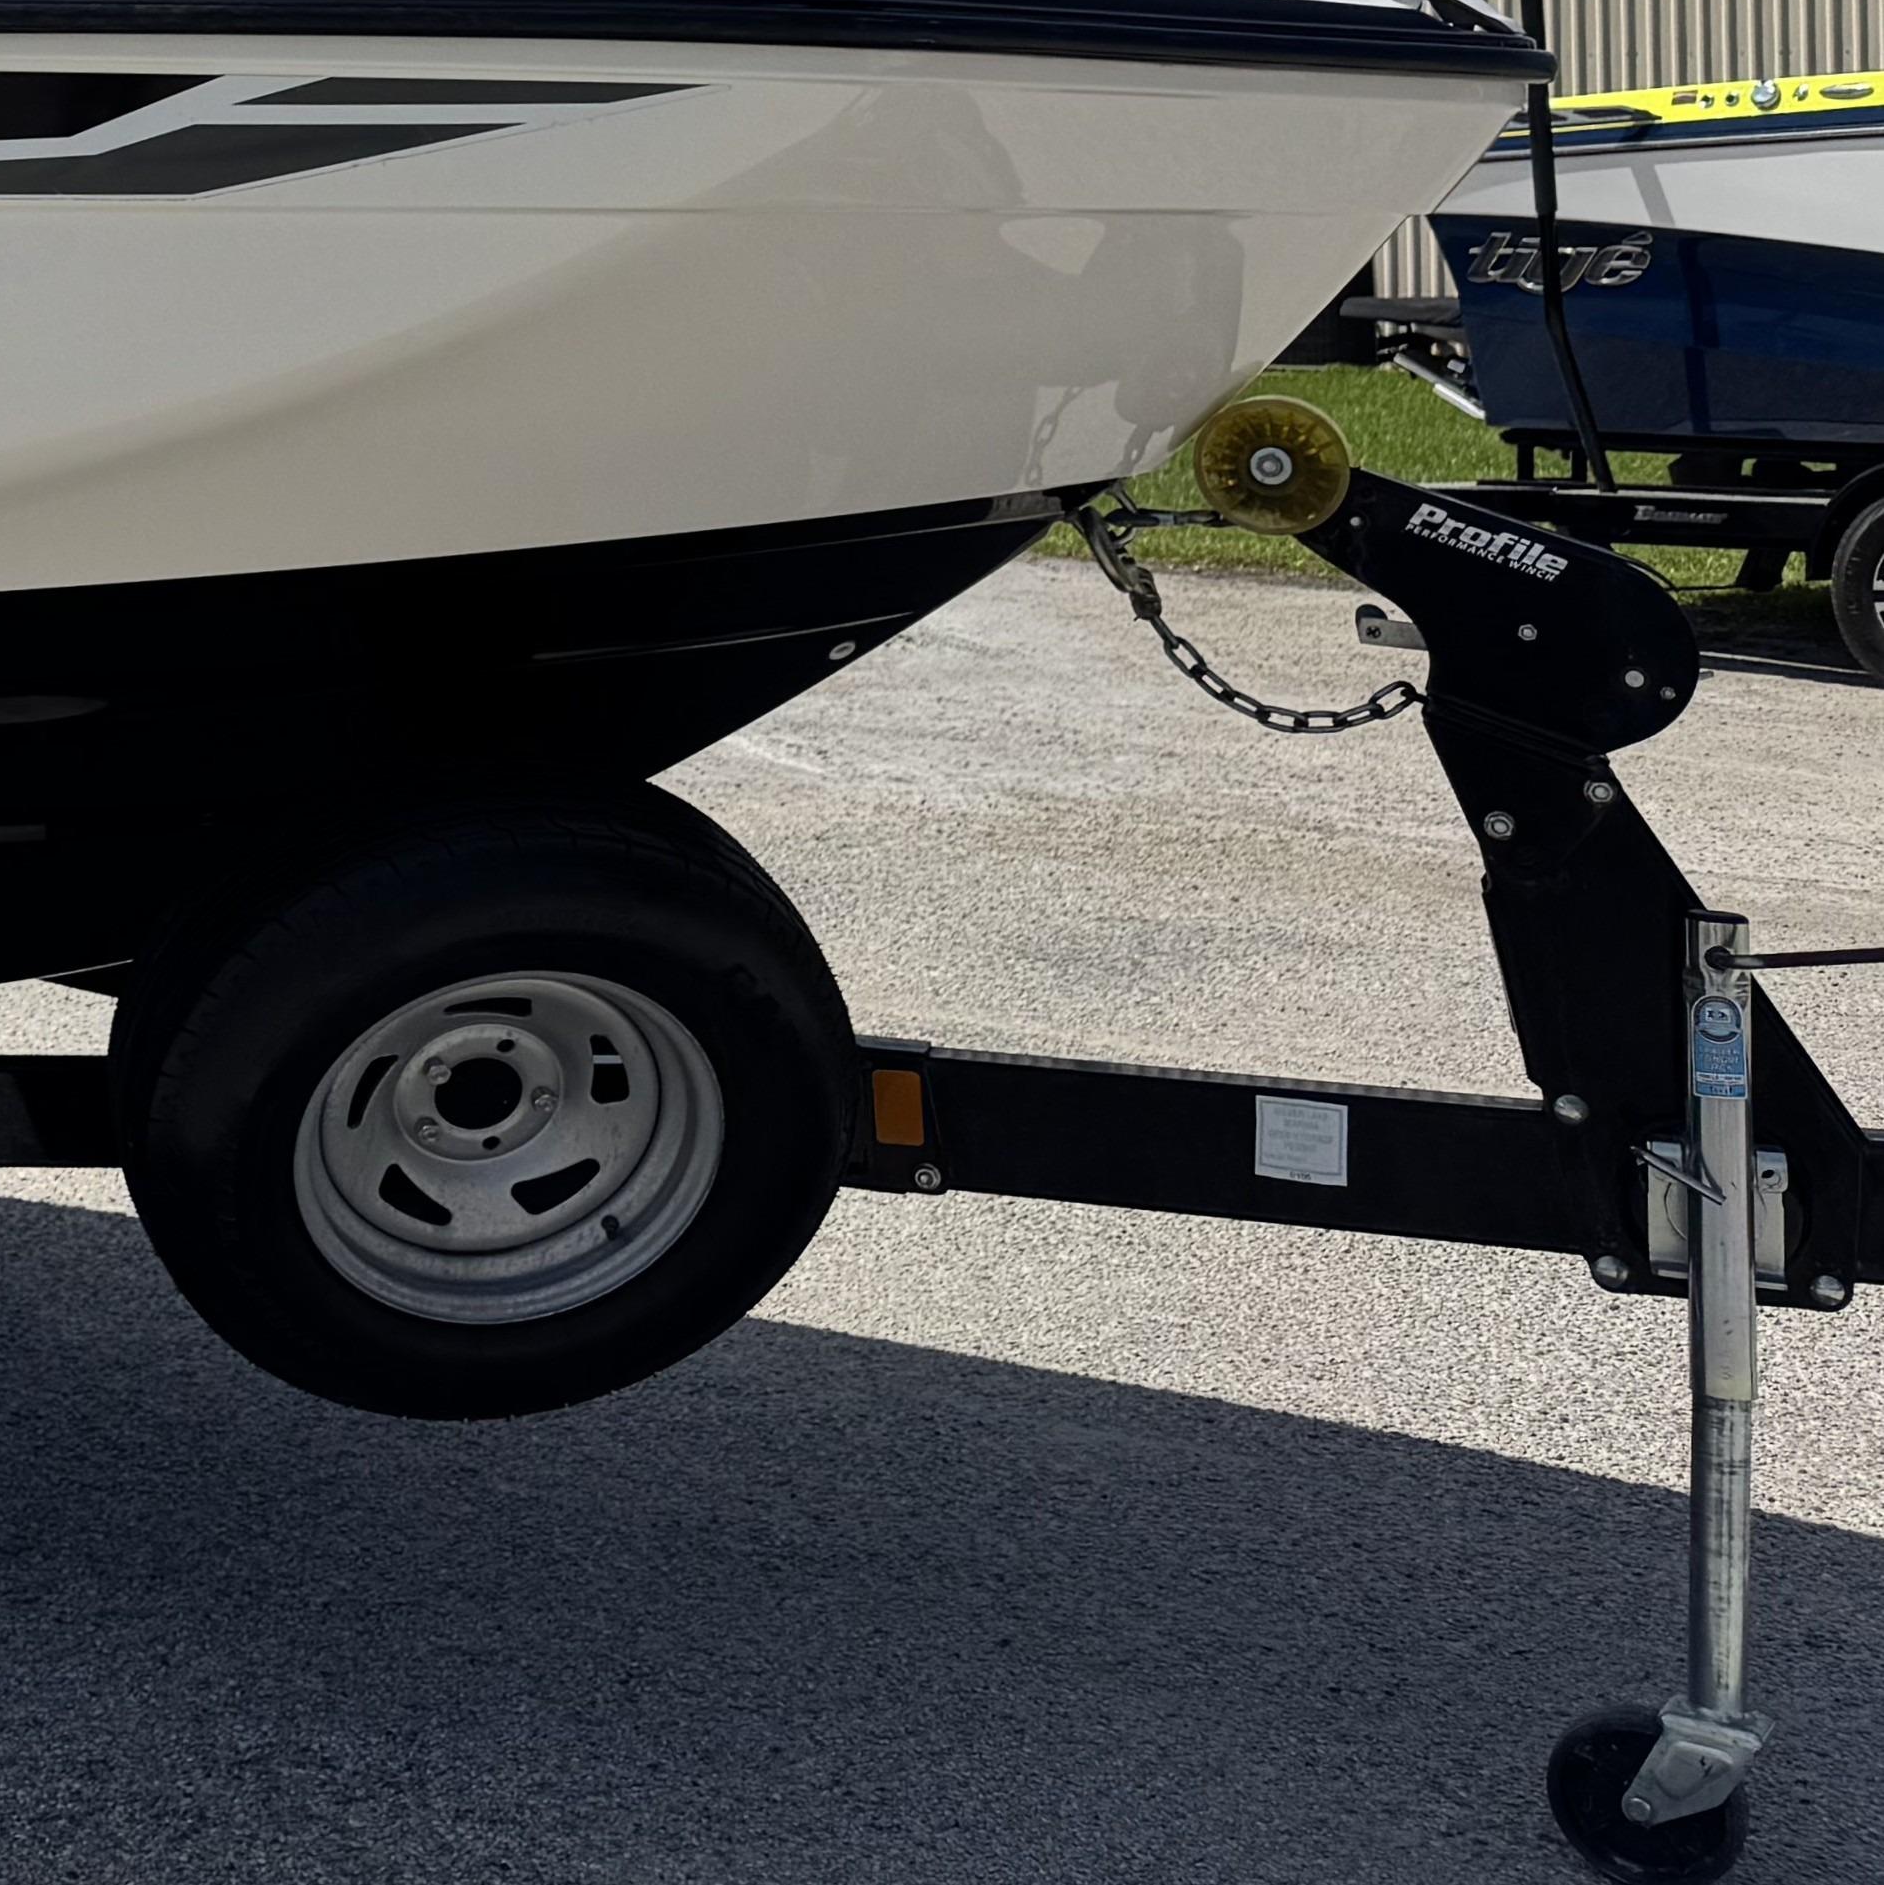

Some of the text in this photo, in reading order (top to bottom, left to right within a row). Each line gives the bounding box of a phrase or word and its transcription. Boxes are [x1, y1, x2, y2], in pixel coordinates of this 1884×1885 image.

[1404, 523, 1556, 582] PERFORMANCE WINCH
[1408, 502, 1569, 576] Profile
